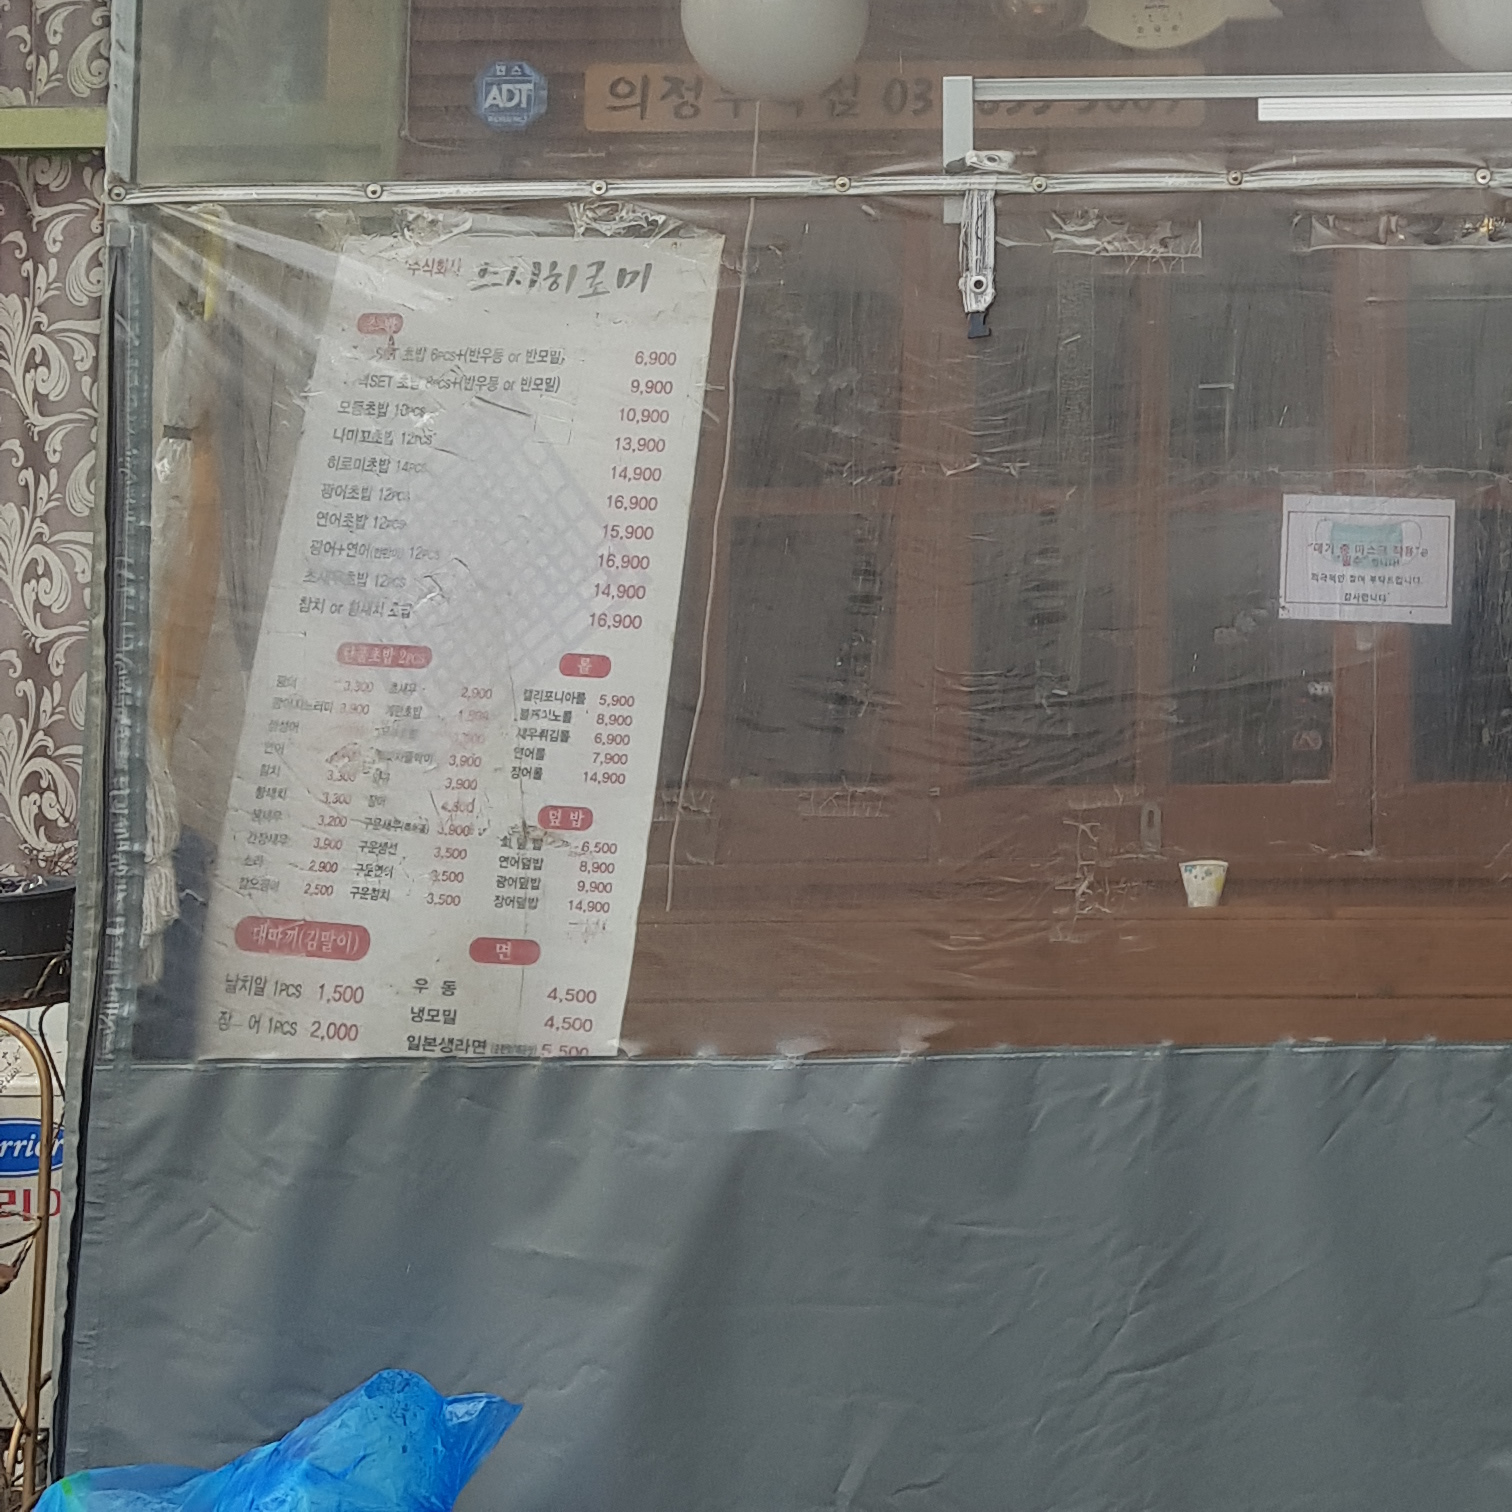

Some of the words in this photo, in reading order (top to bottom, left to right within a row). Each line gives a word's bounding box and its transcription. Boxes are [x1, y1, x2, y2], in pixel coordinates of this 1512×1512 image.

[484, 83, 534, 109] ADT
[508, 352, 521, 363] or
[634, 351, 677, 367] 6,900
[629, 379, 674, 396] 9,900
[618, 407, 670, 425] 10,900
[614, 436, 666, 454] 13,900
[326, 455, 392, 474] 히로미초밥
[610, 465, 662, 483] 14,900
[606, 494, 658, 511] 16,900
[601, 523, 654, 541] 15,900
[597, 553, 650, 570] 16,900
[593, 582, 646, 600] 14,900
[329, 603, 344, 615] or
[588, 612, 642, 630] 16,900
[461, 686, 493, 700] 2,900
[598, 693, 636, 708] 5,900
[595, 712, 633, 727] 8,900
[593, 732, 631, 746] 6,900
[448, 753, 482, 768] 3,900
[591, 751, 629, 766] 7,900
[444, 777, 478, 791] 3,900
[582, 770, 627, 785] 14,900
[317, 814, 348, 828] 3,200
[312, 836, 344, 851] 3,900
[580, 840, 618, 855] 6,500
[433, 845, 468, 860] 3,500
[307, 859, 339, 874] 2,900
[578, 859, 616, 875] 8,900
[430, 869, 465, 884] 3,500
[303, 882, 334, 897] 2,500
[576, 879, 613, 894] 9,900
[425, 892, 462, 907] 3,500
[567, 899, 611, 914] 14,900
[495, 941, 512, 961] 면
[318, 982, 365, 1005] 1,500
[546, 986, 598, 1004] 4,500
[409, 1005, 458, 1026] 냉모밀
[543, 1015, 594, 1033] 4,500
[309, 1020, 360, 1042] 2,000
[406, 1034, 488, 1055] 일본생라면
[541, 1043, 590, 1056] 5500
